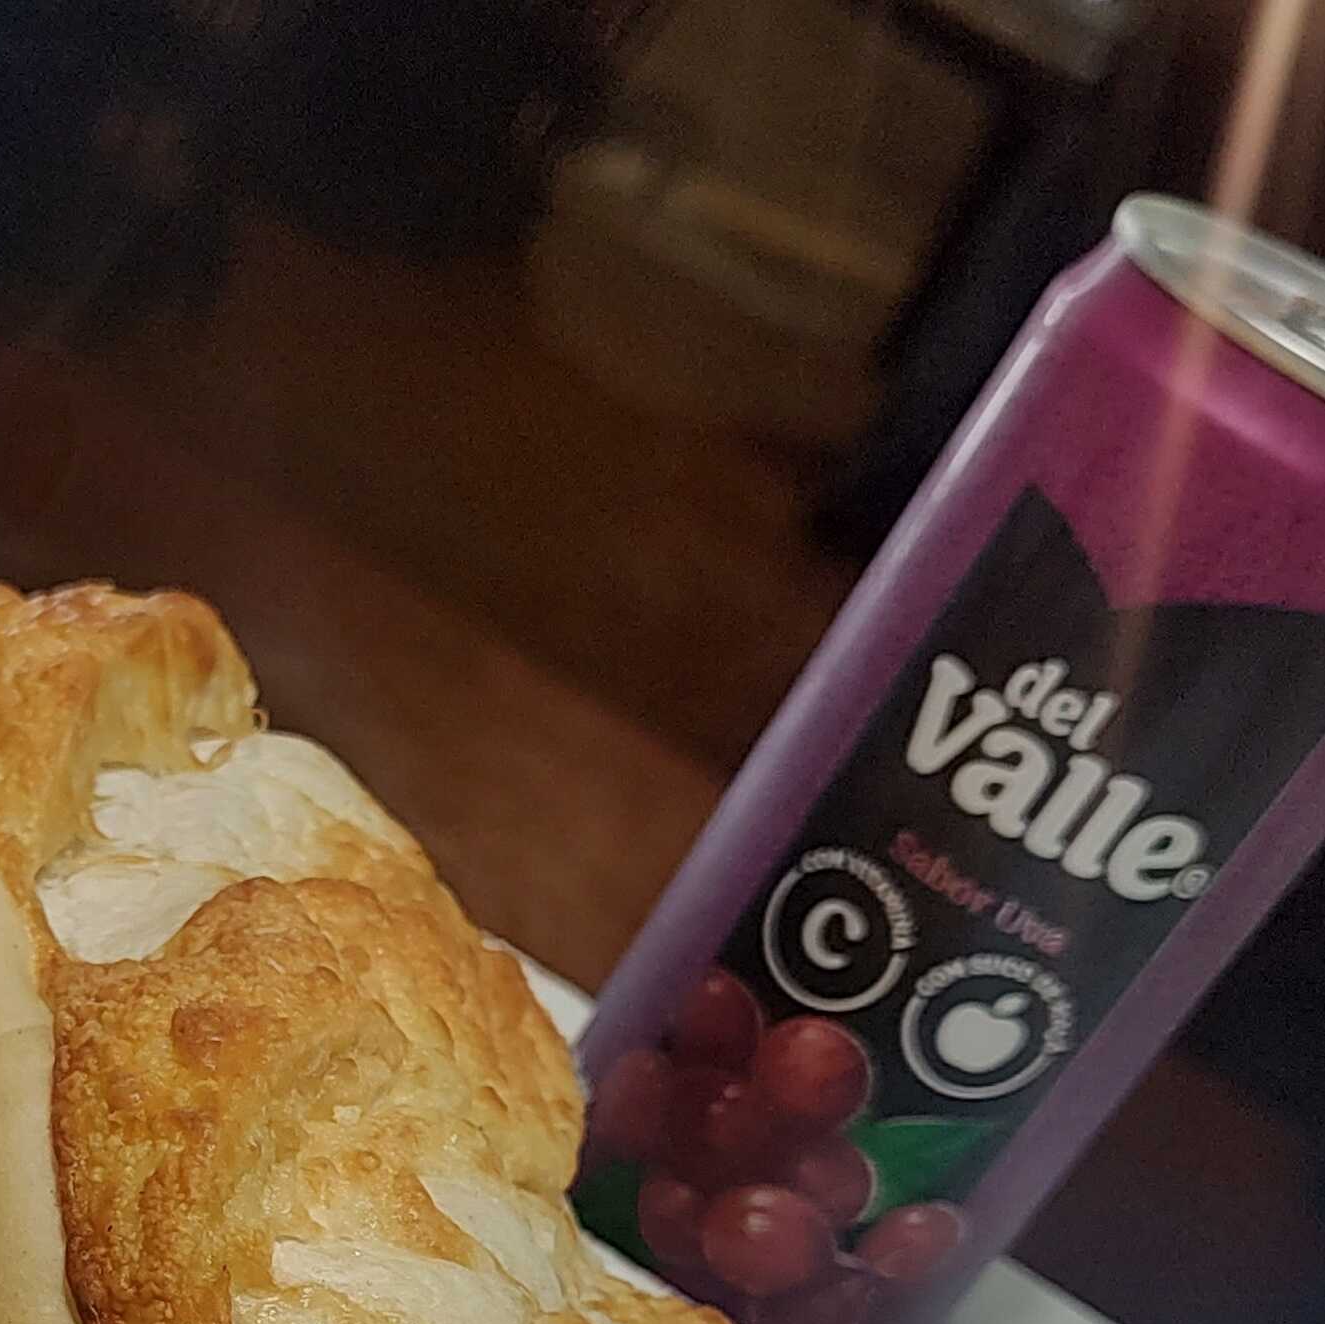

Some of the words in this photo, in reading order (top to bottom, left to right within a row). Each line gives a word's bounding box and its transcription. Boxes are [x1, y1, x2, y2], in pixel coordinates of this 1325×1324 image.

[1004, 657, 1118, 751] del
[906, 653, 1207, 901] Valle
[888, 832, 995, 912] Sabor
[802, 899, 868, 970] C
